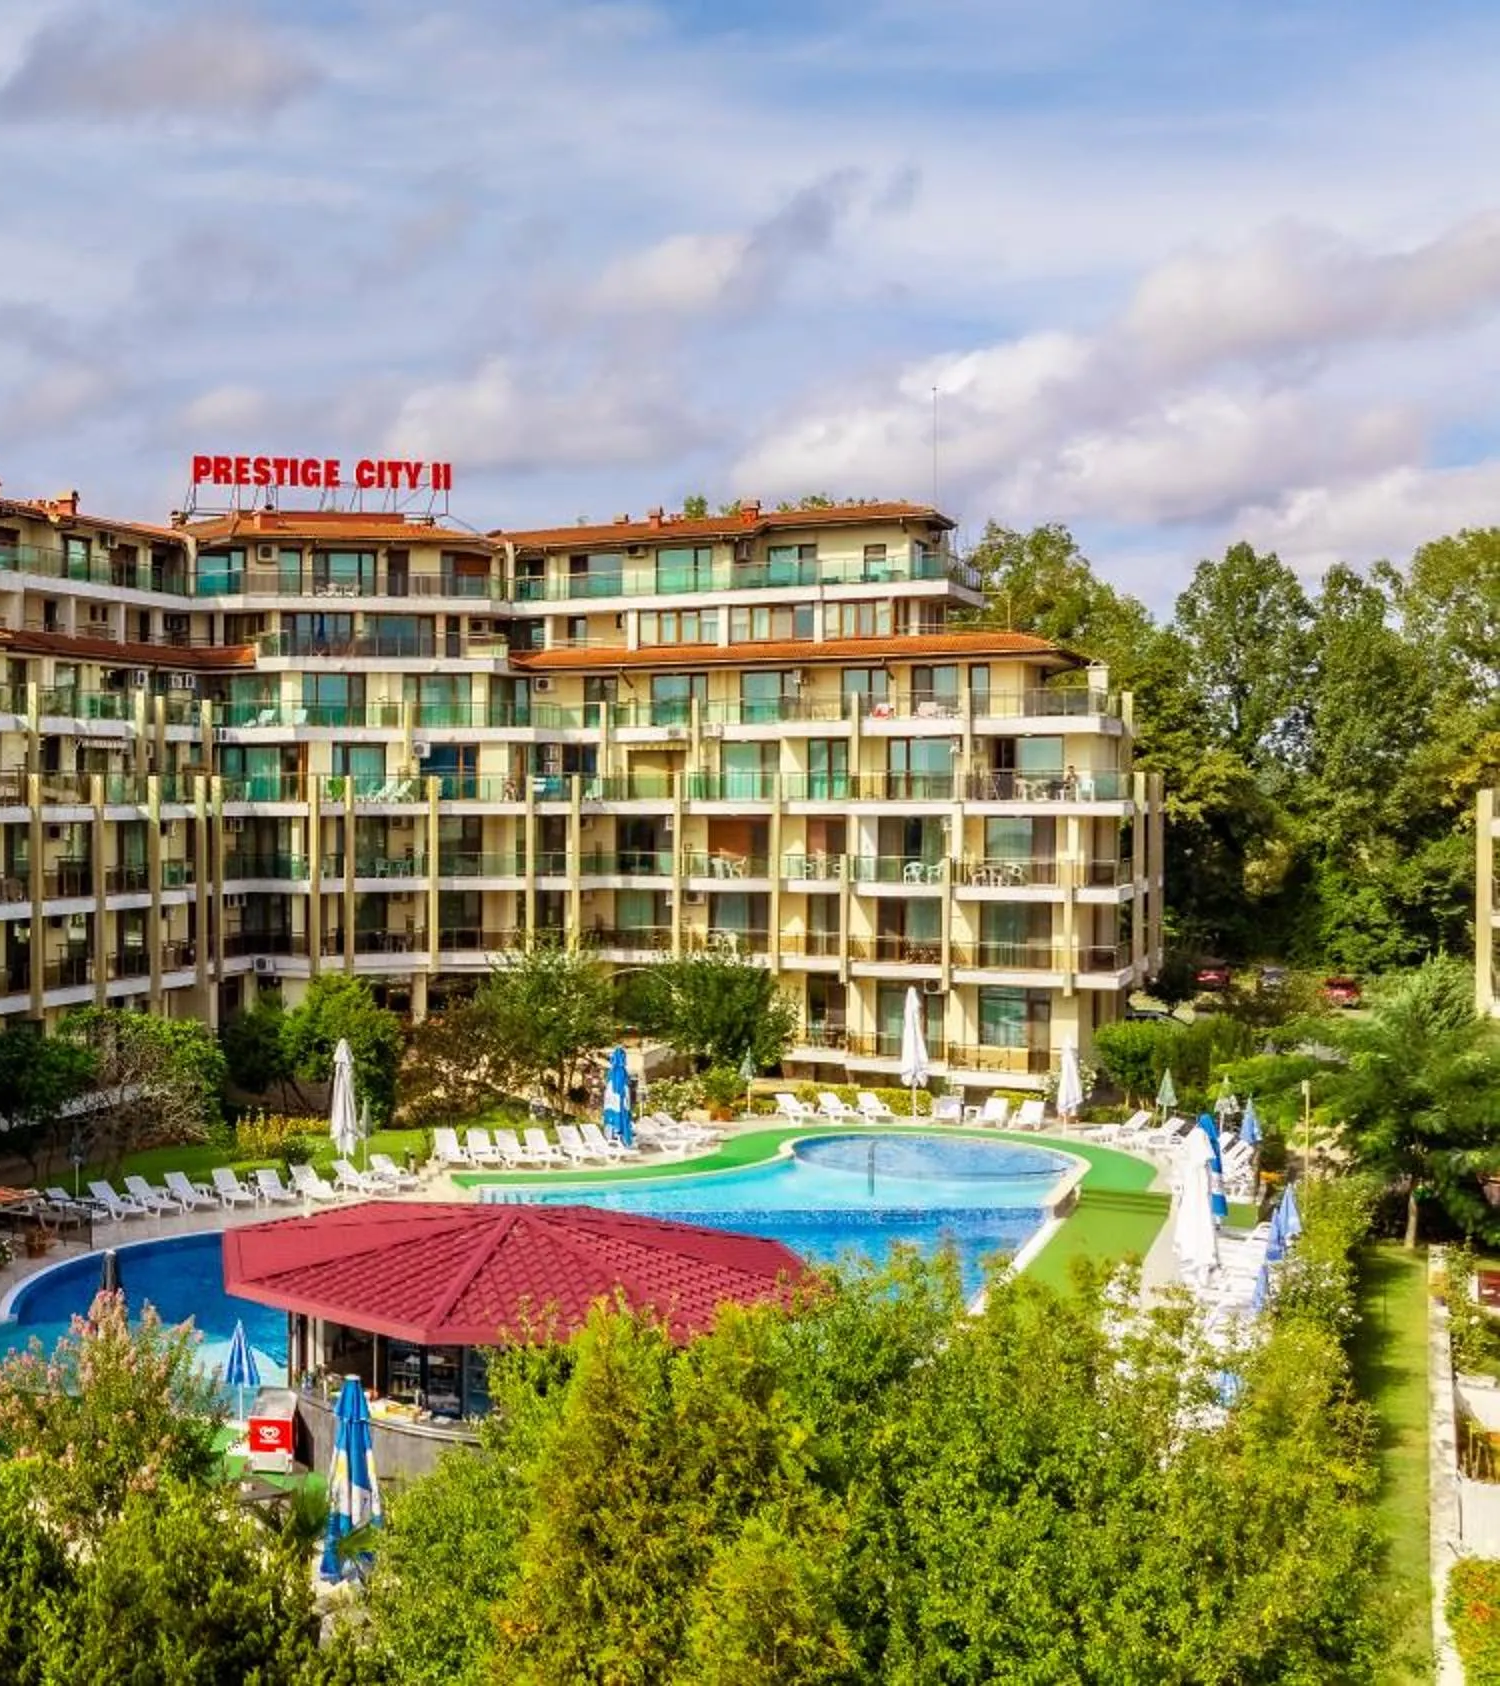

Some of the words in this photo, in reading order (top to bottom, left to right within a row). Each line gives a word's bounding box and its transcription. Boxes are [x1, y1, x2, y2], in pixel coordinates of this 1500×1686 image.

[191, 455, 341, 489] PRESTIGE
[355, 459, 424, 490] CITY
[431, 462, 452, 491] II
